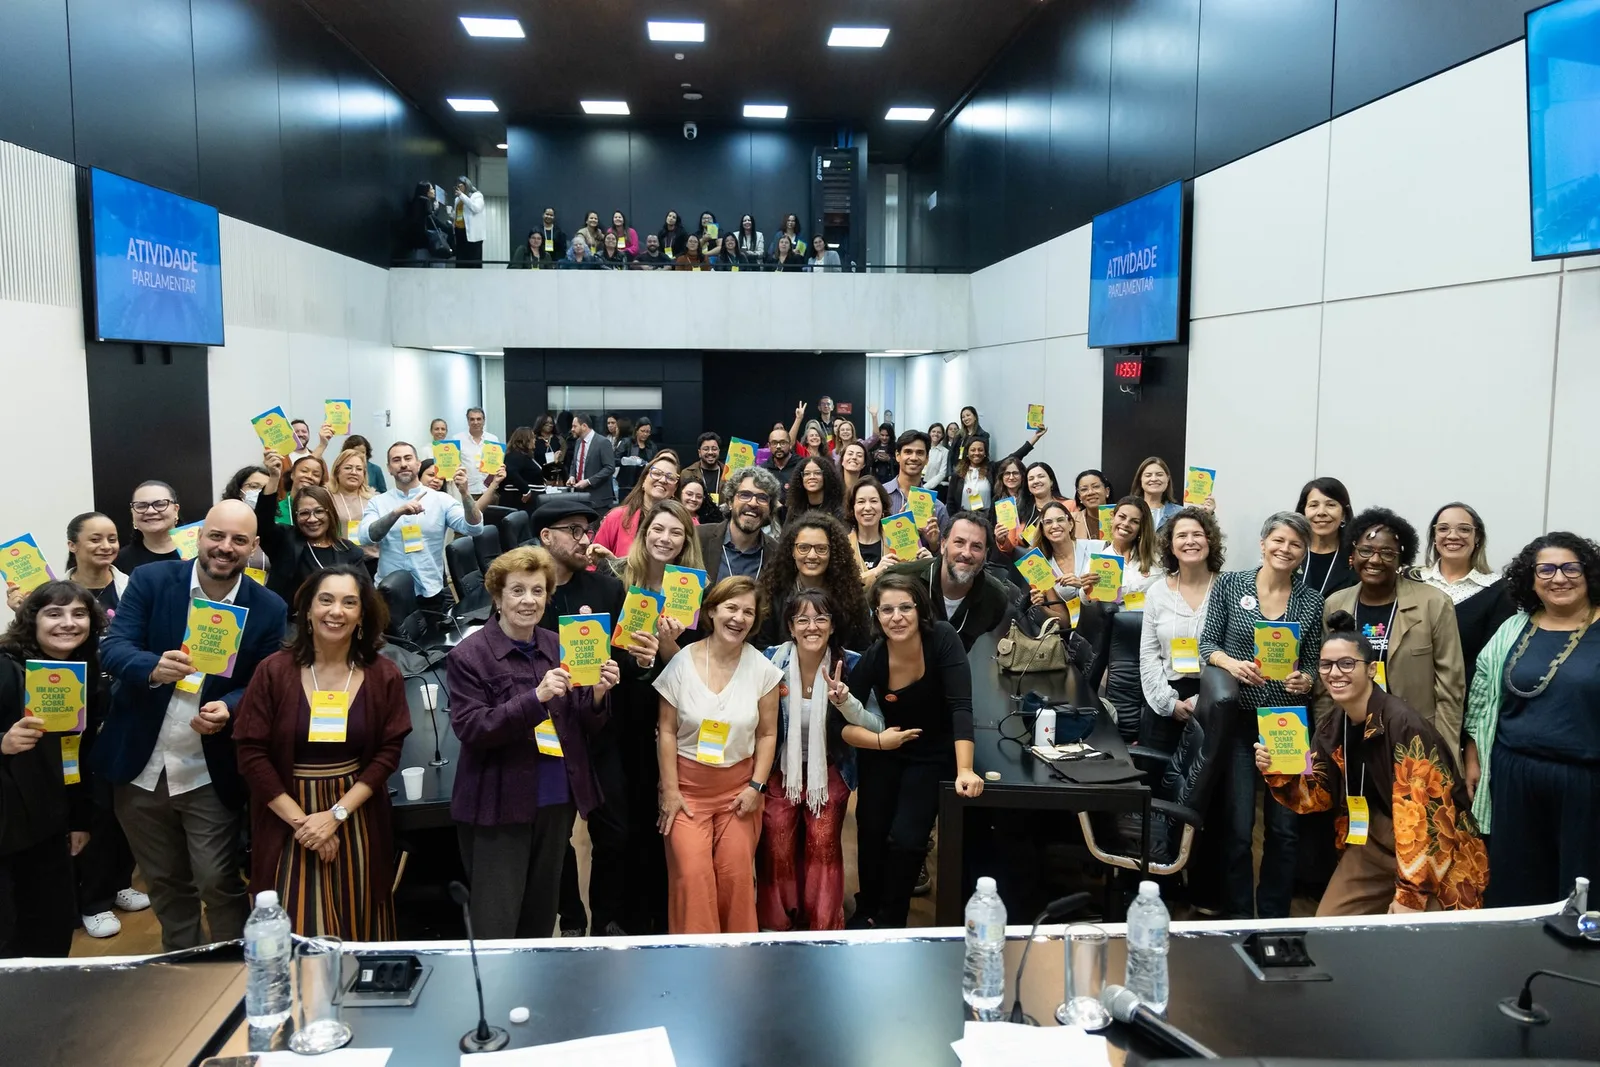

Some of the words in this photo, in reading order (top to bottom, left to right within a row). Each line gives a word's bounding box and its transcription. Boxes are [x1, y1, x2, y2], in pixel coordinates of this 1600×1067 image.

[127, 237, 198, 273] ATIVIDADE
[1106, 245, 1158, 280] ATIVIDADE
[132, 269, 196, 294] PARLAMENTAR
[1108, 276, 1154, 298] PARLAMENTAR
[637, 610, 650, 618] NOVO
[632, 615, 645, 623] OLHAR
[630, 620, 643, 629] SOBRE
[208, 627, 228, 635] NOVO
[201, 632, 222, 641] OLHAR
[199, 639, 221, 648] SOBRE
[199, 646, 227, 655] BRINCAR
